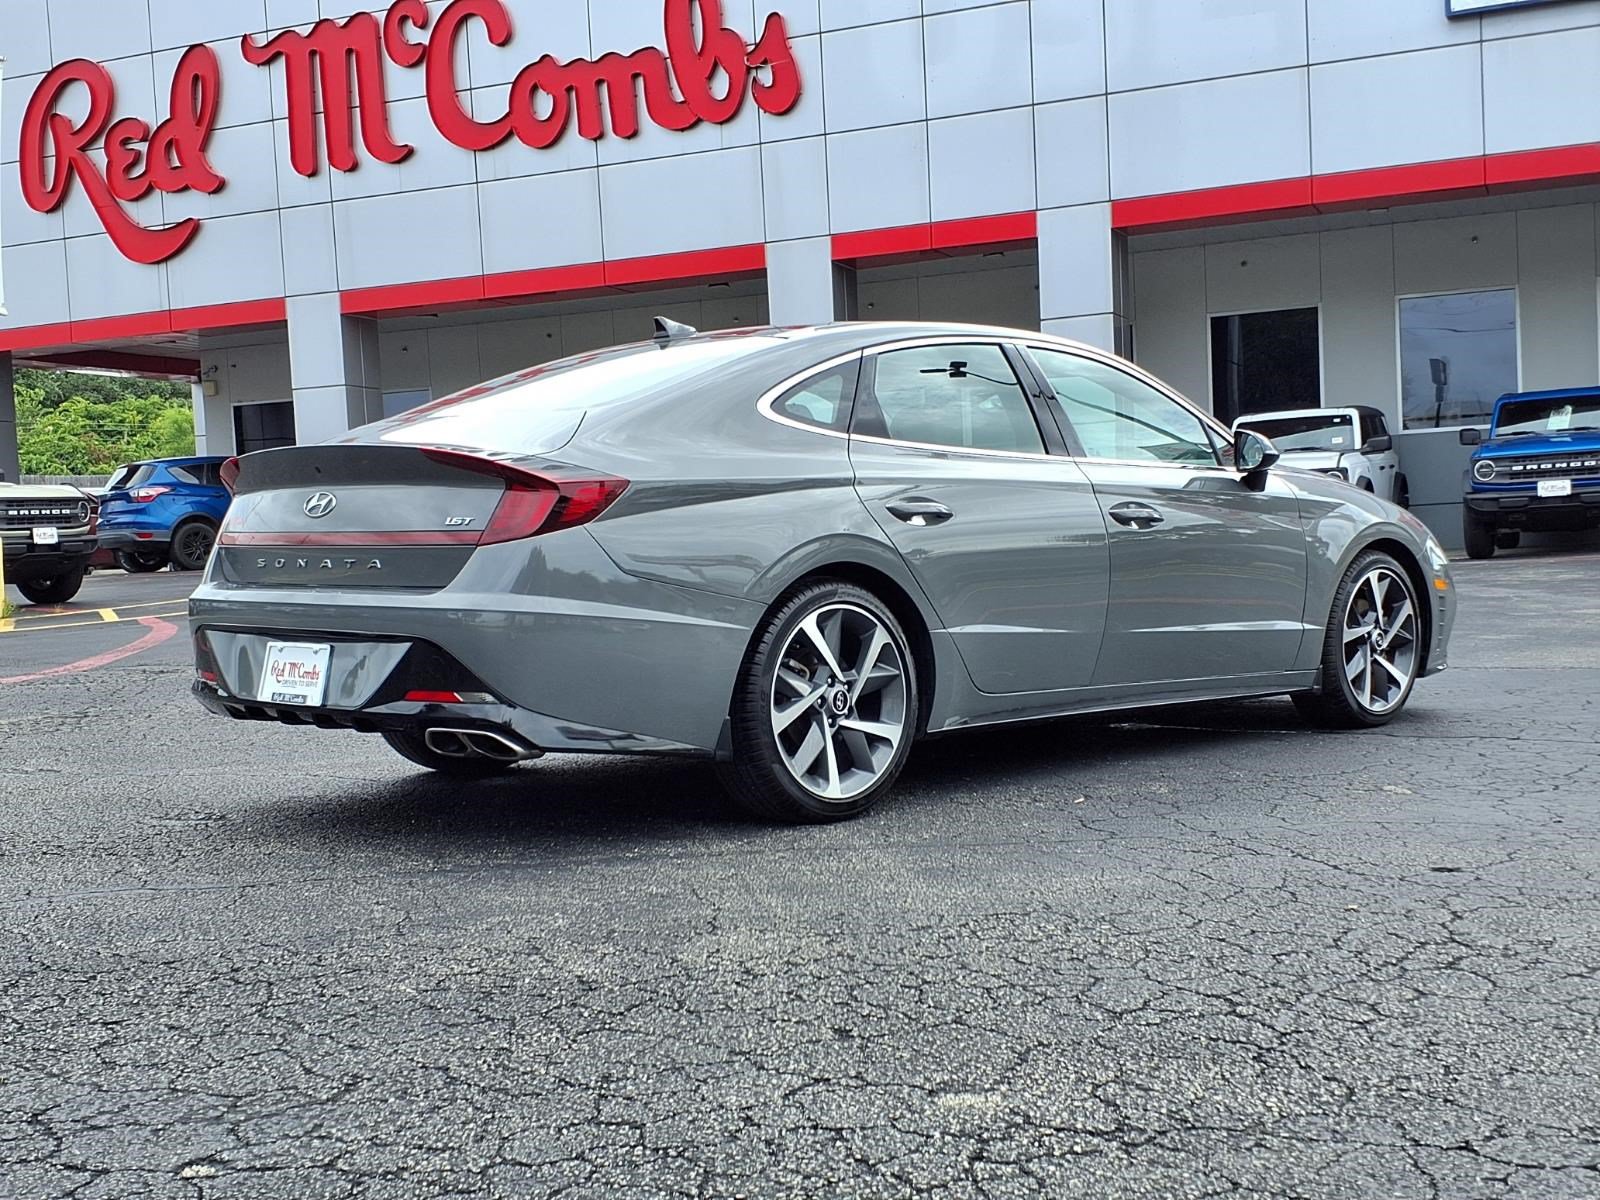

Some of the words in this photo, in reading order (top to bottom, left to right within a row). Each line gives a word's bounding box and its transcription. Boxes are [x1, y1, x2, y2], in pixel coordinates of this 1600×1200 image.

[20, 44, 225, 263] Red
[241, 0, 801, 177] McCombs
[1512, 460, 1597, 471] BRONCO
[257, 558, 382, 569] SONATA
[271, 660, 286, 683] Red
